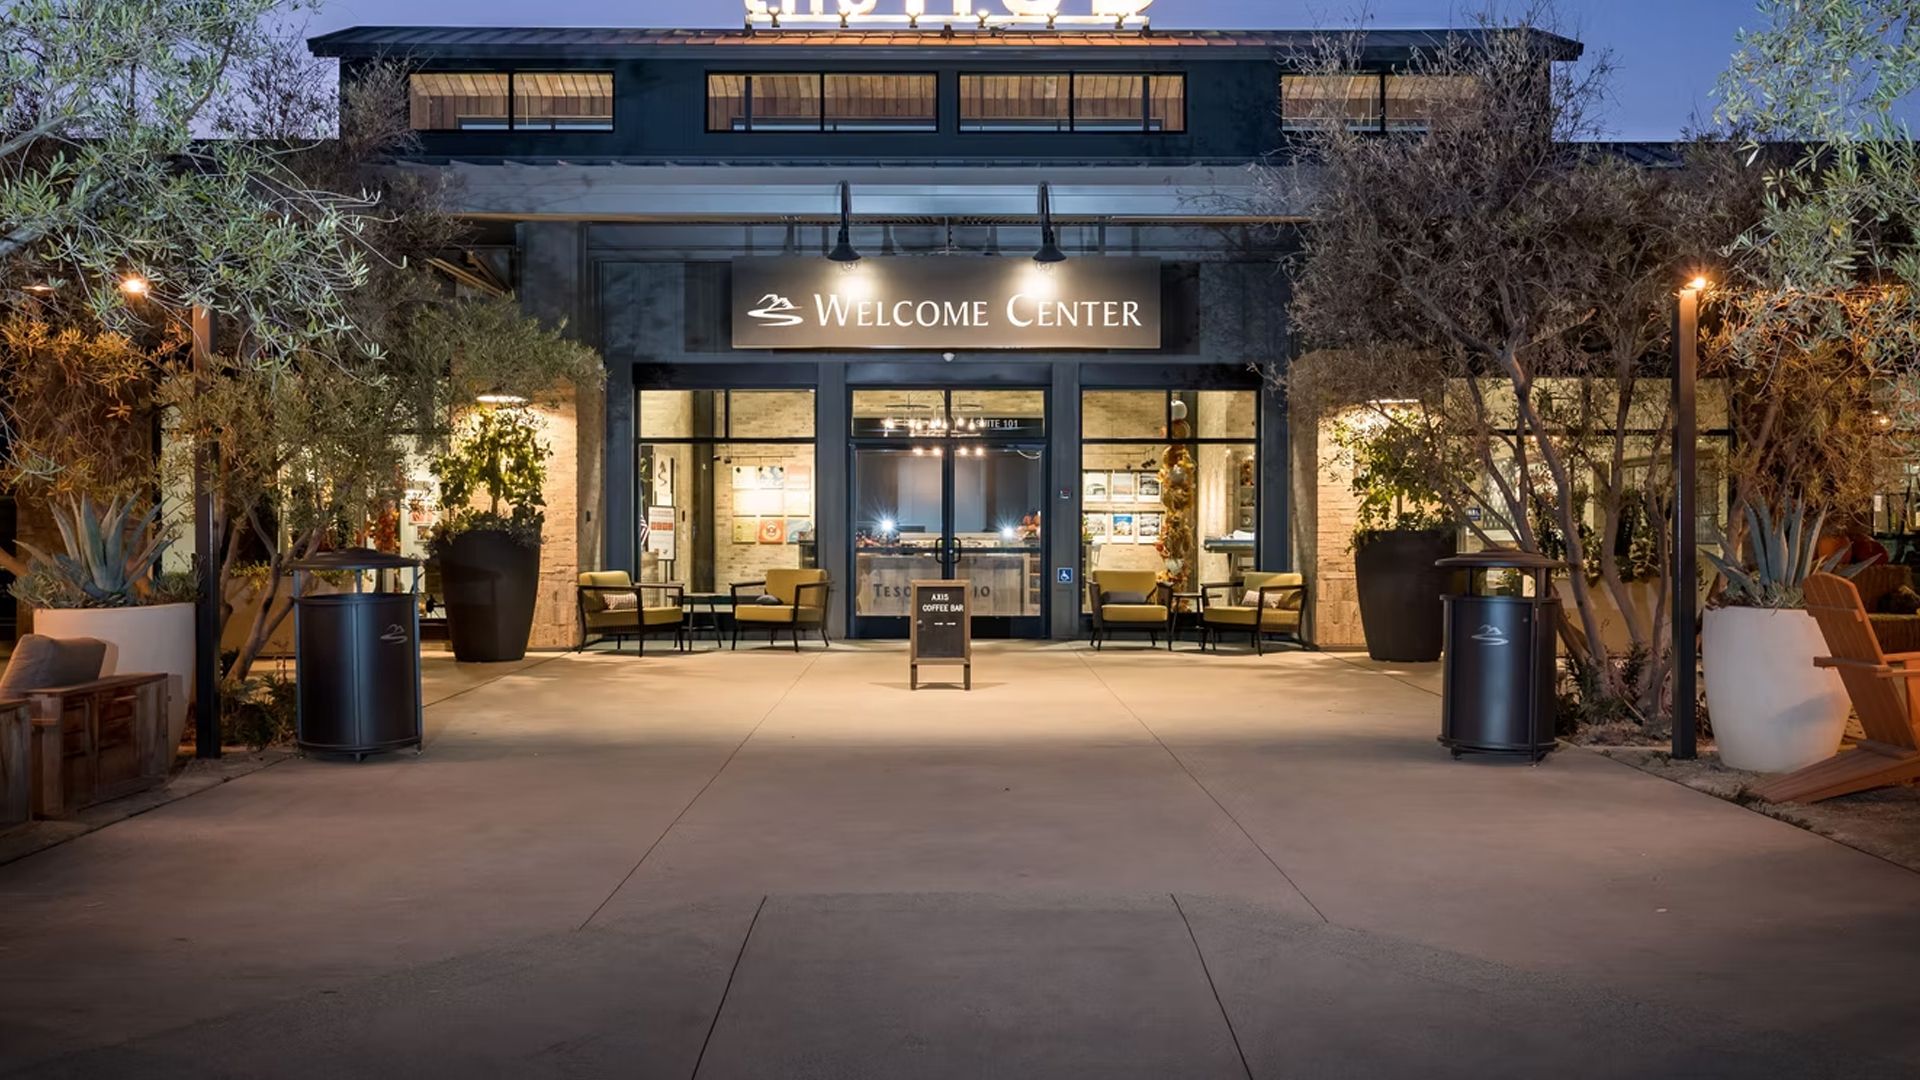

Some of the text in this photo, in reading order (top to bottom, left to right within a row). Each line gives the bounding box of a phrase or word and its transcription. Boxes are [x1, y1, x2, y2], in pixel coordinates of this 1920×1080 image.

[814, 294, 1141, 327] WELCOME CENTER
[1003, 419, 1018, 428] 101
[873, 584, 911, 598] TESO
[922, 604, 964, 612] COFFEE BAR
